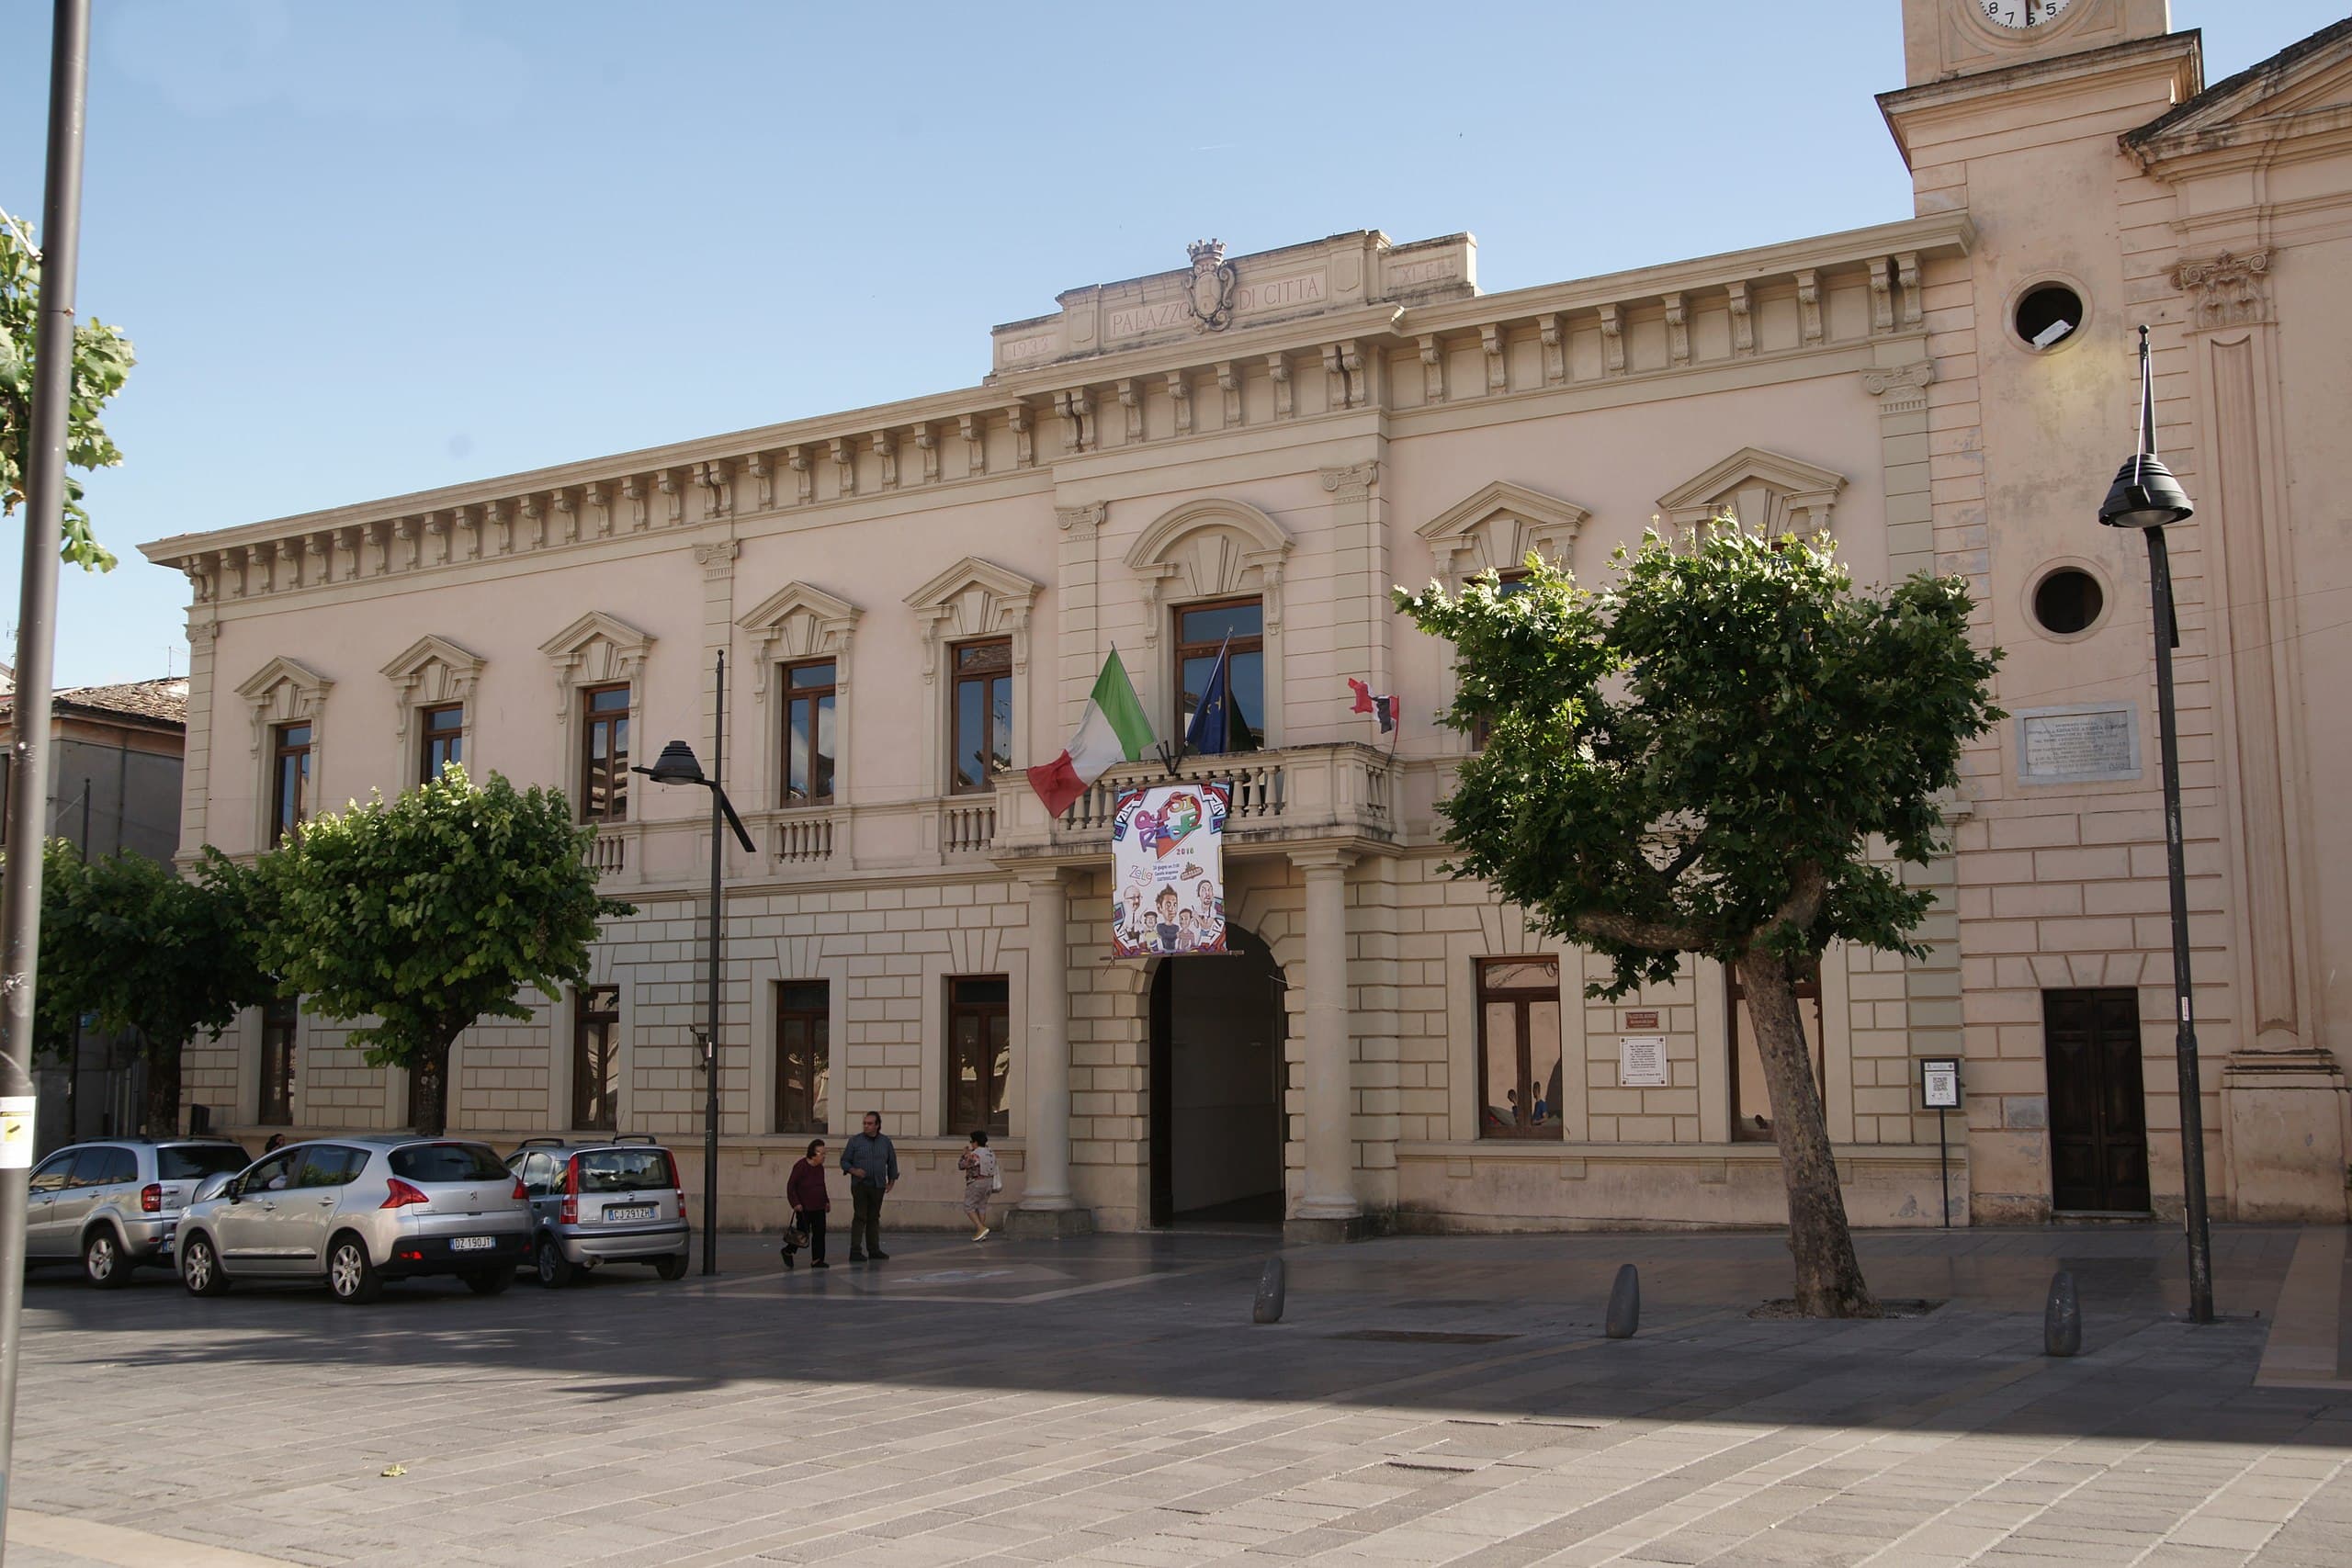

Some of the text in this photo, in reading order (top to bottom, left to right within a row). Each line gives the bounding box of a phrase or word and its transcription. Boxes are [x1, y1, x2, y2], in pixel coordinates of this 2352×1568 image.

[1988, 2, 1998, 14] 8
[2046, 2, 2056, 16] 5
[2005, 11, 2015, 24] 7
[1113, 300, 1193, 335] PALAZZO
[1239, 287, 1256, 310] DI
[1170, 791, 1196, 814] SI
[1139, 811, 1203, 853] RIDE
[455, 1238, 465, 1248] DZ
